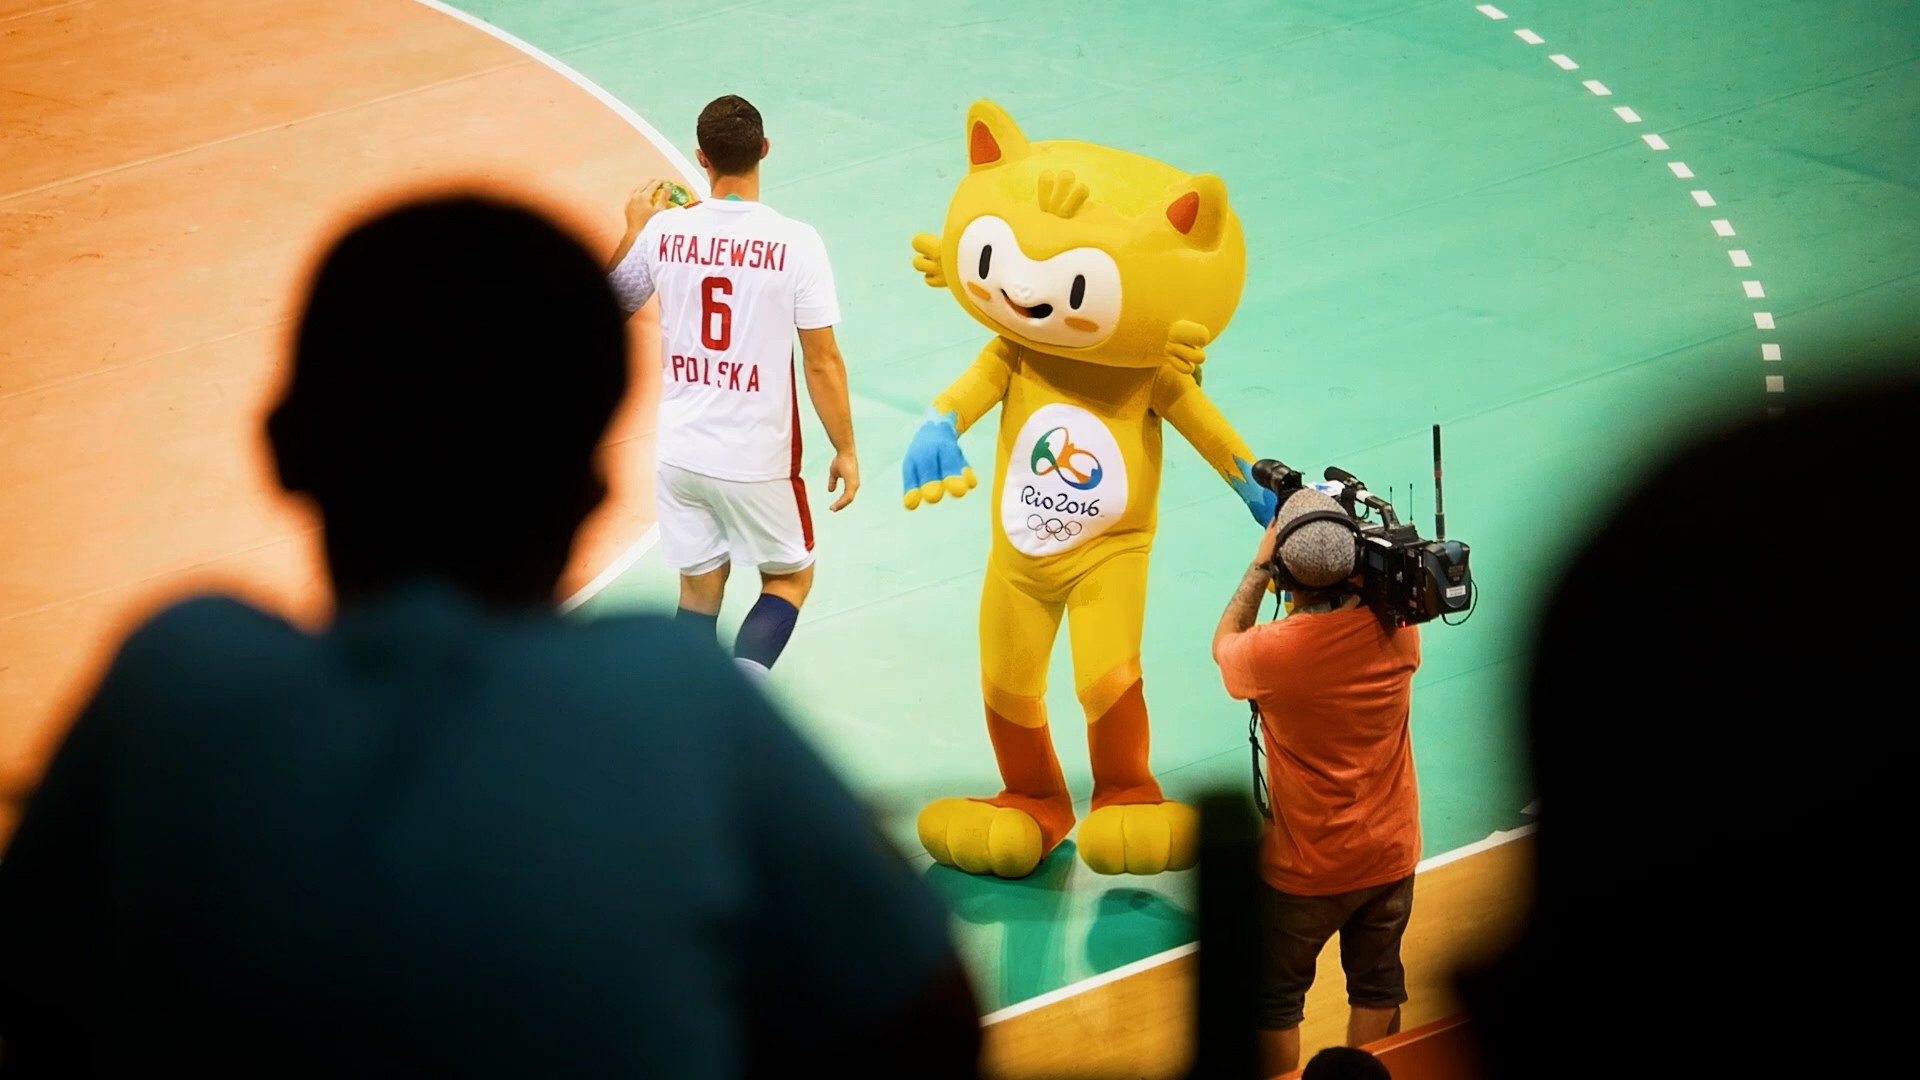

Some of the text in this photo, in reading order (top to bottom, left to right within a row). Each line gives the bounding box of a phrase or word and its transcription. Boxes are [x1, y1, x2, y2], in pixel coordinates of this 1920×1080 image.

[659, 233, 787, 271] KRAJEWSKI
[701, 276, 733, 351] 6
[671, 355, 760, 392] POLSKA
